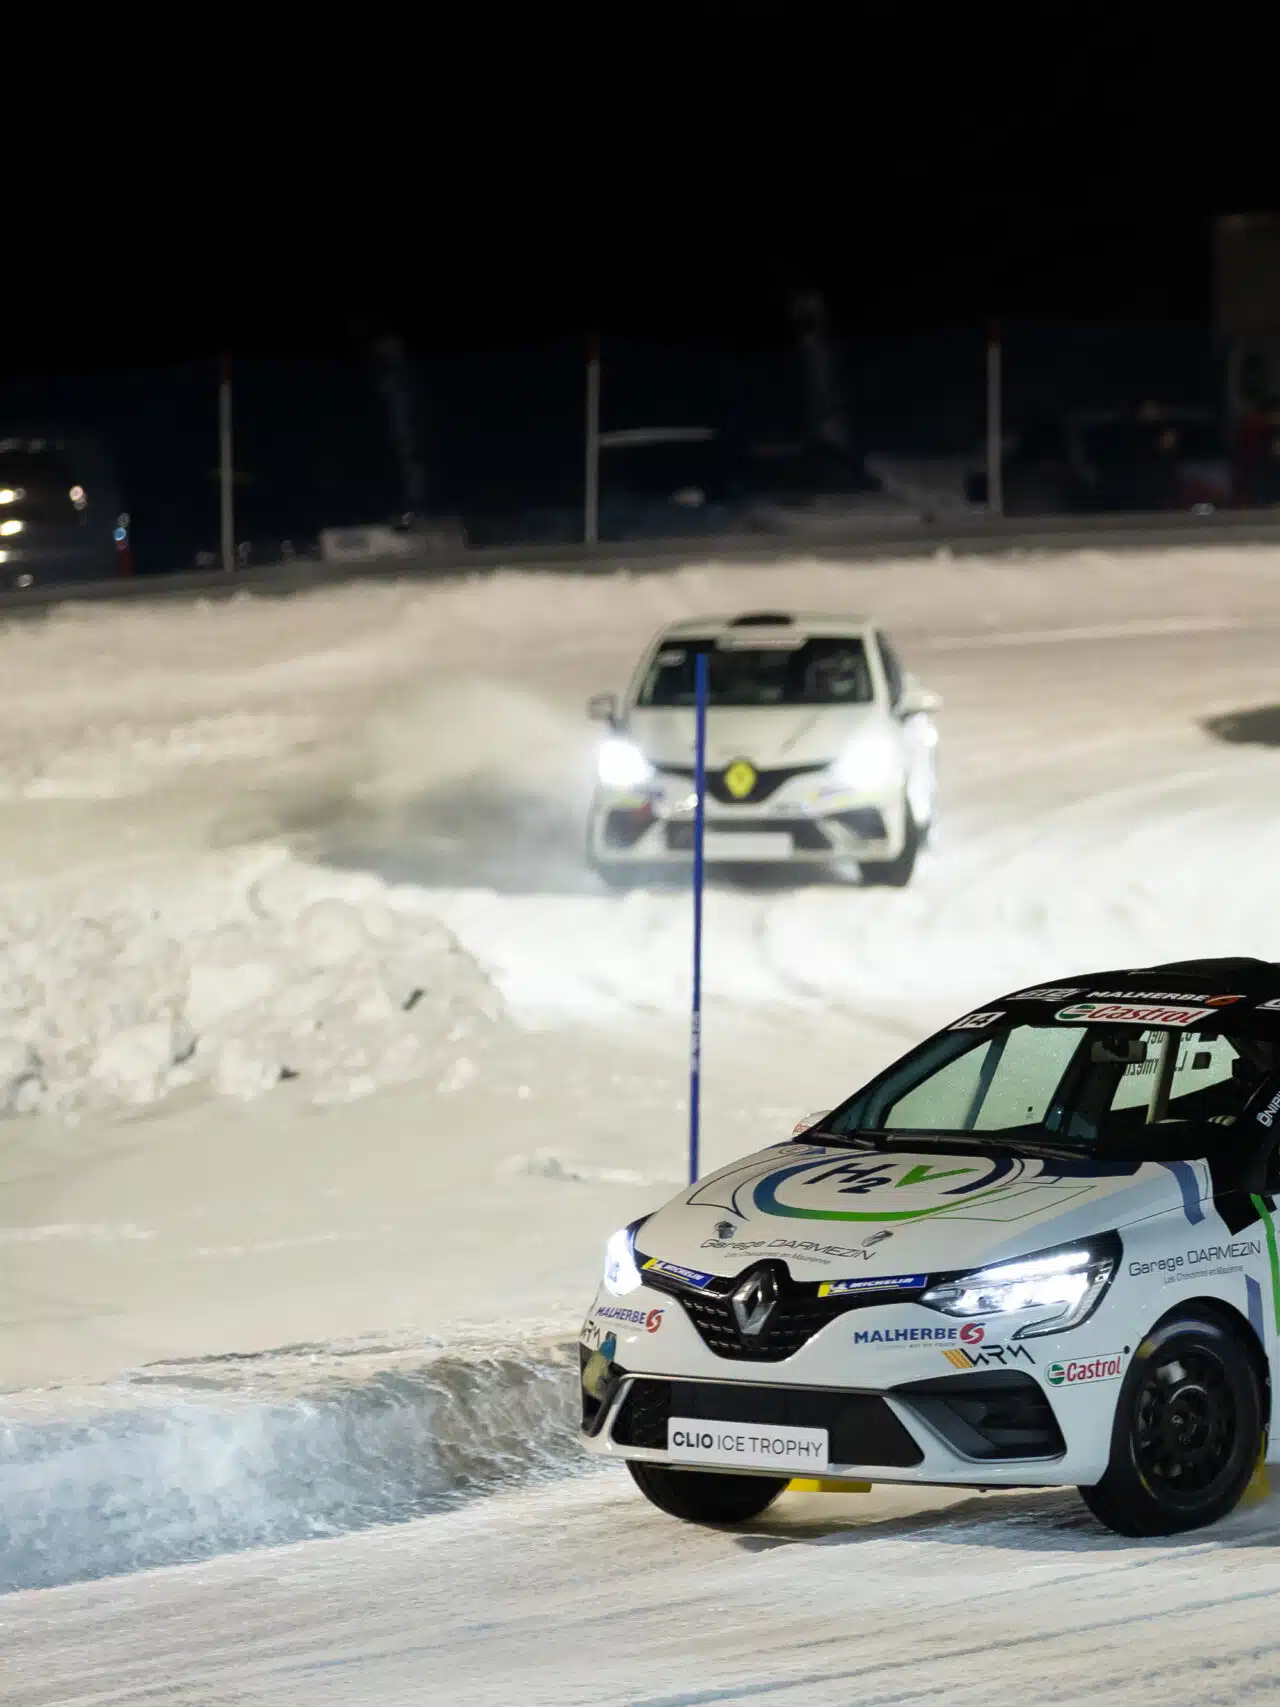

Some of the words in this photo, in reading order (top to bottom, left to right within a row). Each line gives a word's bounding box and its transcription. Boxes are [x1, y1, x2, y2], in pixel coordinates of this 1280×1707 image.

[1087, 991, 1208, 1001] MALHERBE
[965, 1014, 991, 1027] 14
[1090, 1004, 1204, 1025] Castrol
[802, 1162, 980, 1194] H2V
[700, 1238, 763, 1251] Garage
[767, 1239, 876, 1260] DARMEZIN
[1129, 1255, 1184, 1276] Garage
[1187, 1240, 1261, 1264] DARMEZIN
[849, 1277, 914, 1289] MICHELIN
[595, 1307, 646, 1324] MALHERBE
[854, 1328, 957, 1344] MALHERBE
[1066, 1356, 1121, 1383] Castrol
[673, 1432, 713, 1449] CLIO
[717, 1434, 745, 1452] ICE
[749, 1437, 823, 1457] TROPHY
